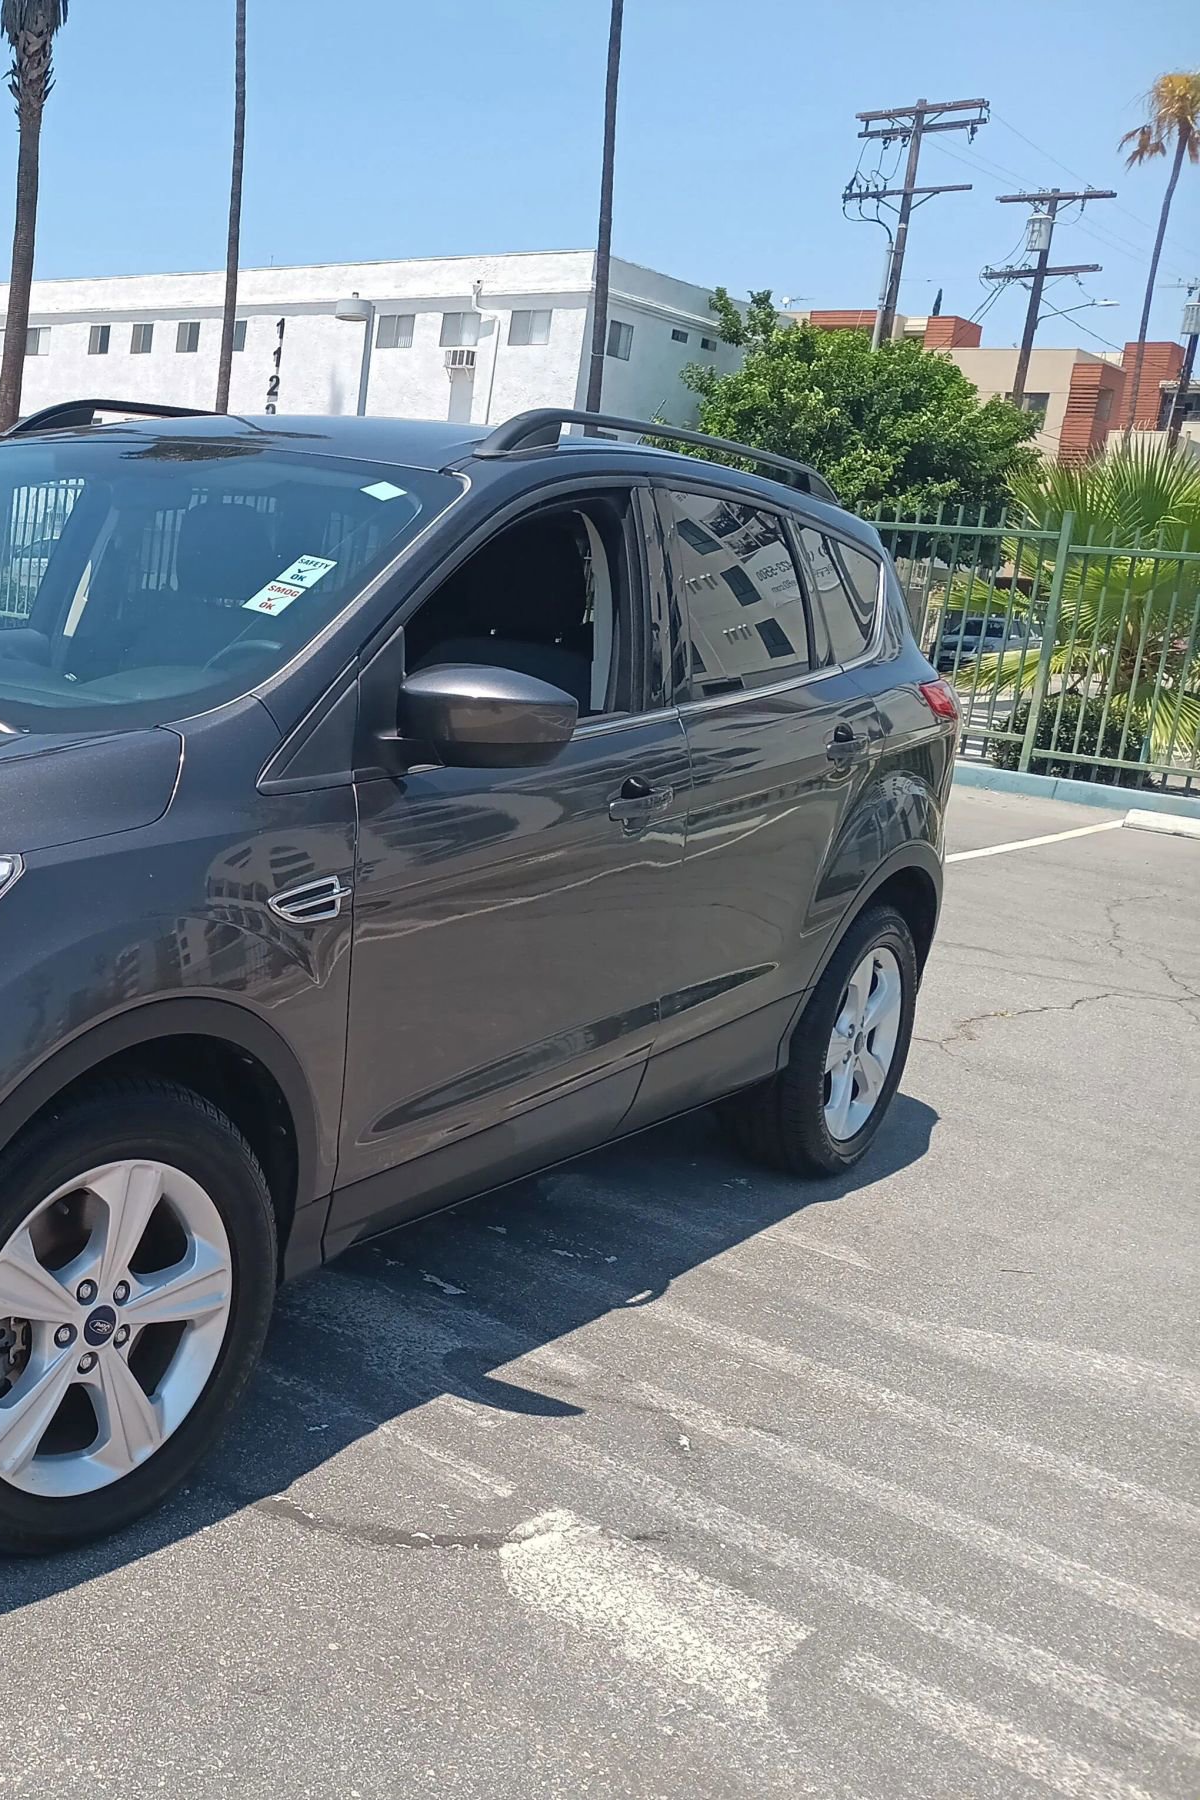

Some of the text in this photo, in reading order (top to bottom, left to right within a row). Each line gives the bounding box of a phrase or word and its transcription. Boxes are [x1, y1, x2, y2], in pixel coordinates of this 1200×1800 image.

[298, 558, 331, 569] SAFETY
[290, 573, 307, 582] OK
[267, 584, 300, 597] SMOG
[259, 601, 276, 610] OK
